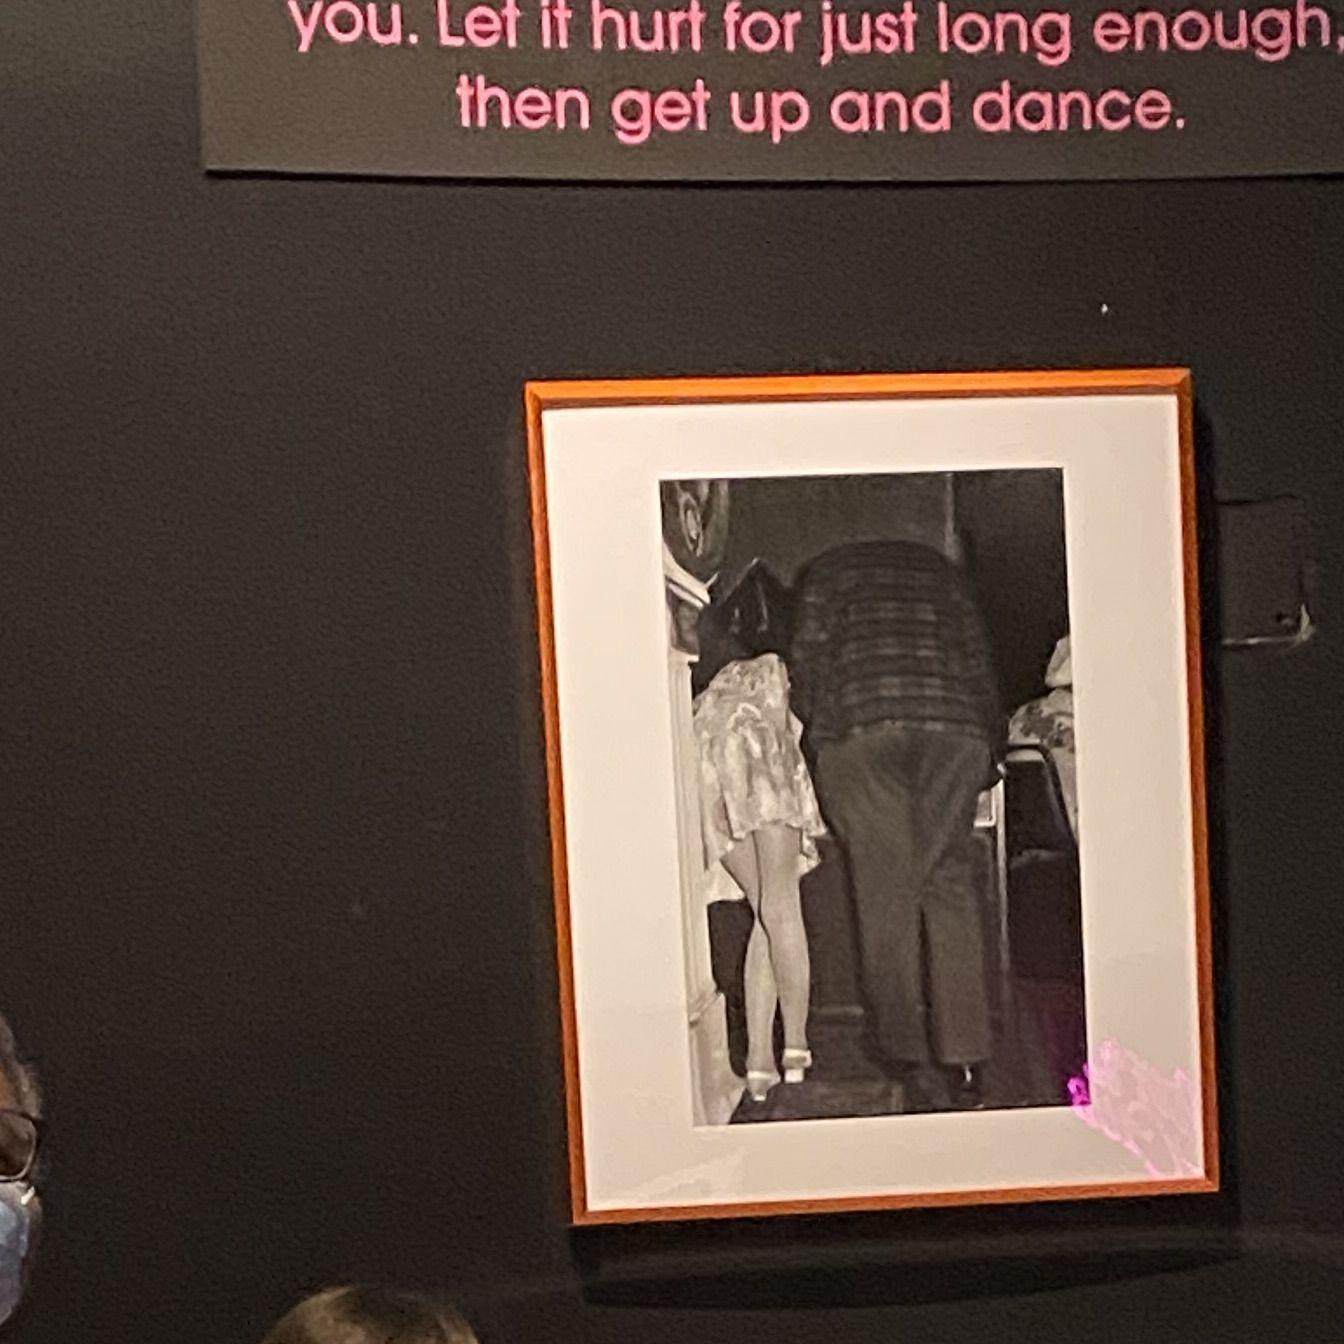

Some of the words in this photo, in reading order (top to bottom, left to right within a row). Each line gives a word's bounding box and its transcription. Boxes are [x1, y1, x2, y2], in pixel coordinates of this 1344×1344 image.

[288, 0, 419, 52] you.
[437, 0, 522, 48] Let
[540, 0, 573, 49] it
[590, 0, 706, 52] hurt
[723, 0, 802, 53] for
[820, 0, 918, 66] just
[937, 2, 1072, 67] long
[456, 74, 590, 130] then
[611, 79, 712, 145] get
[729, 91, 811, 143] up
[830, 80, 951, 132] and
[972, 80, 1186, 132] dance.
